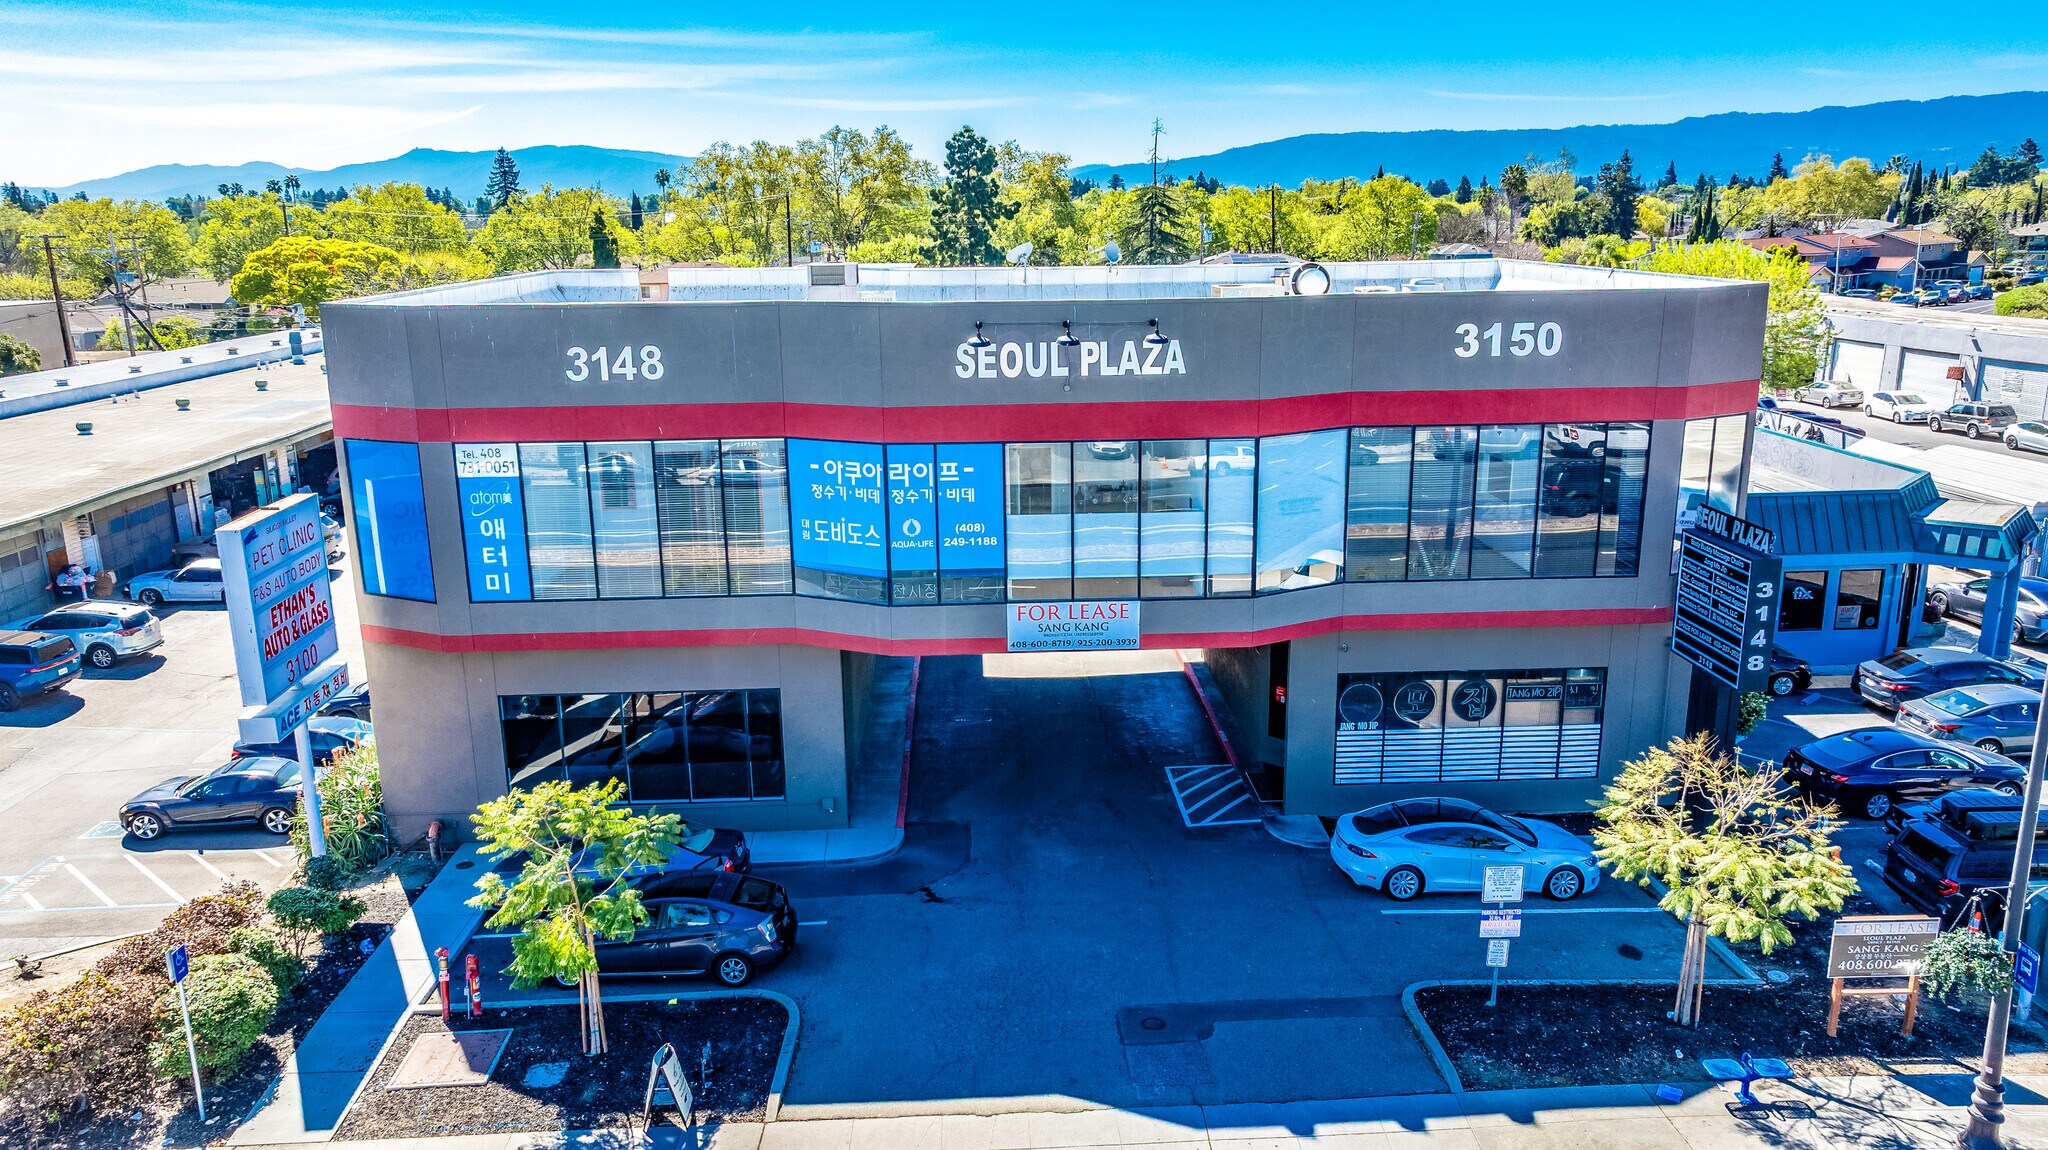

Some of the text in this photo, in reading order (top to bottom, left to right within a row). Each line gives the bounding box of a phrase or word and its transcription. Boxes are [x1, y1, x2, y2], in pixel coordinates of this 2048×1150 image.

[1454, 321, 1563, 358] 3150
[565, 346, 665, 382] 3148
[955, 339, 1187, 379] SEOUL PLAZA
[459, 461, 516, 474] 731-0051
[461, 448, 502, 459] Tel. 408
[943, 537, 998, 547] 249-1188
[955, 523, 985, 534] (408)
[1695, 505, 1770, 554] SEOUL PLAZA
[253, 522, 315, 571] PET CLINIC
[253, 551, 322, 603] F&S AUTO BODY
[270, 583, 316, 630] ETHAN'S
[1017, 603, 1130, 622] FOR LEASE
[264, 600, 329, 662] AUTO & GLASS
[1038, 622, 1110, 633] SANG KANG
[1747, 582, 1774, 671] 3148
[286, 643, 318, 683] 3100
[1508, 686, 1561, 698] JANG MO ZIP
[281, 705, 301, 735] ACE
[1340, 722, 1355, 731] JANG
[1357, 721, 1368, 730] MO
[1853, 922, 1934, 934] FOR LEASE
[1847, 944, 1919, 954] SANG KANG
